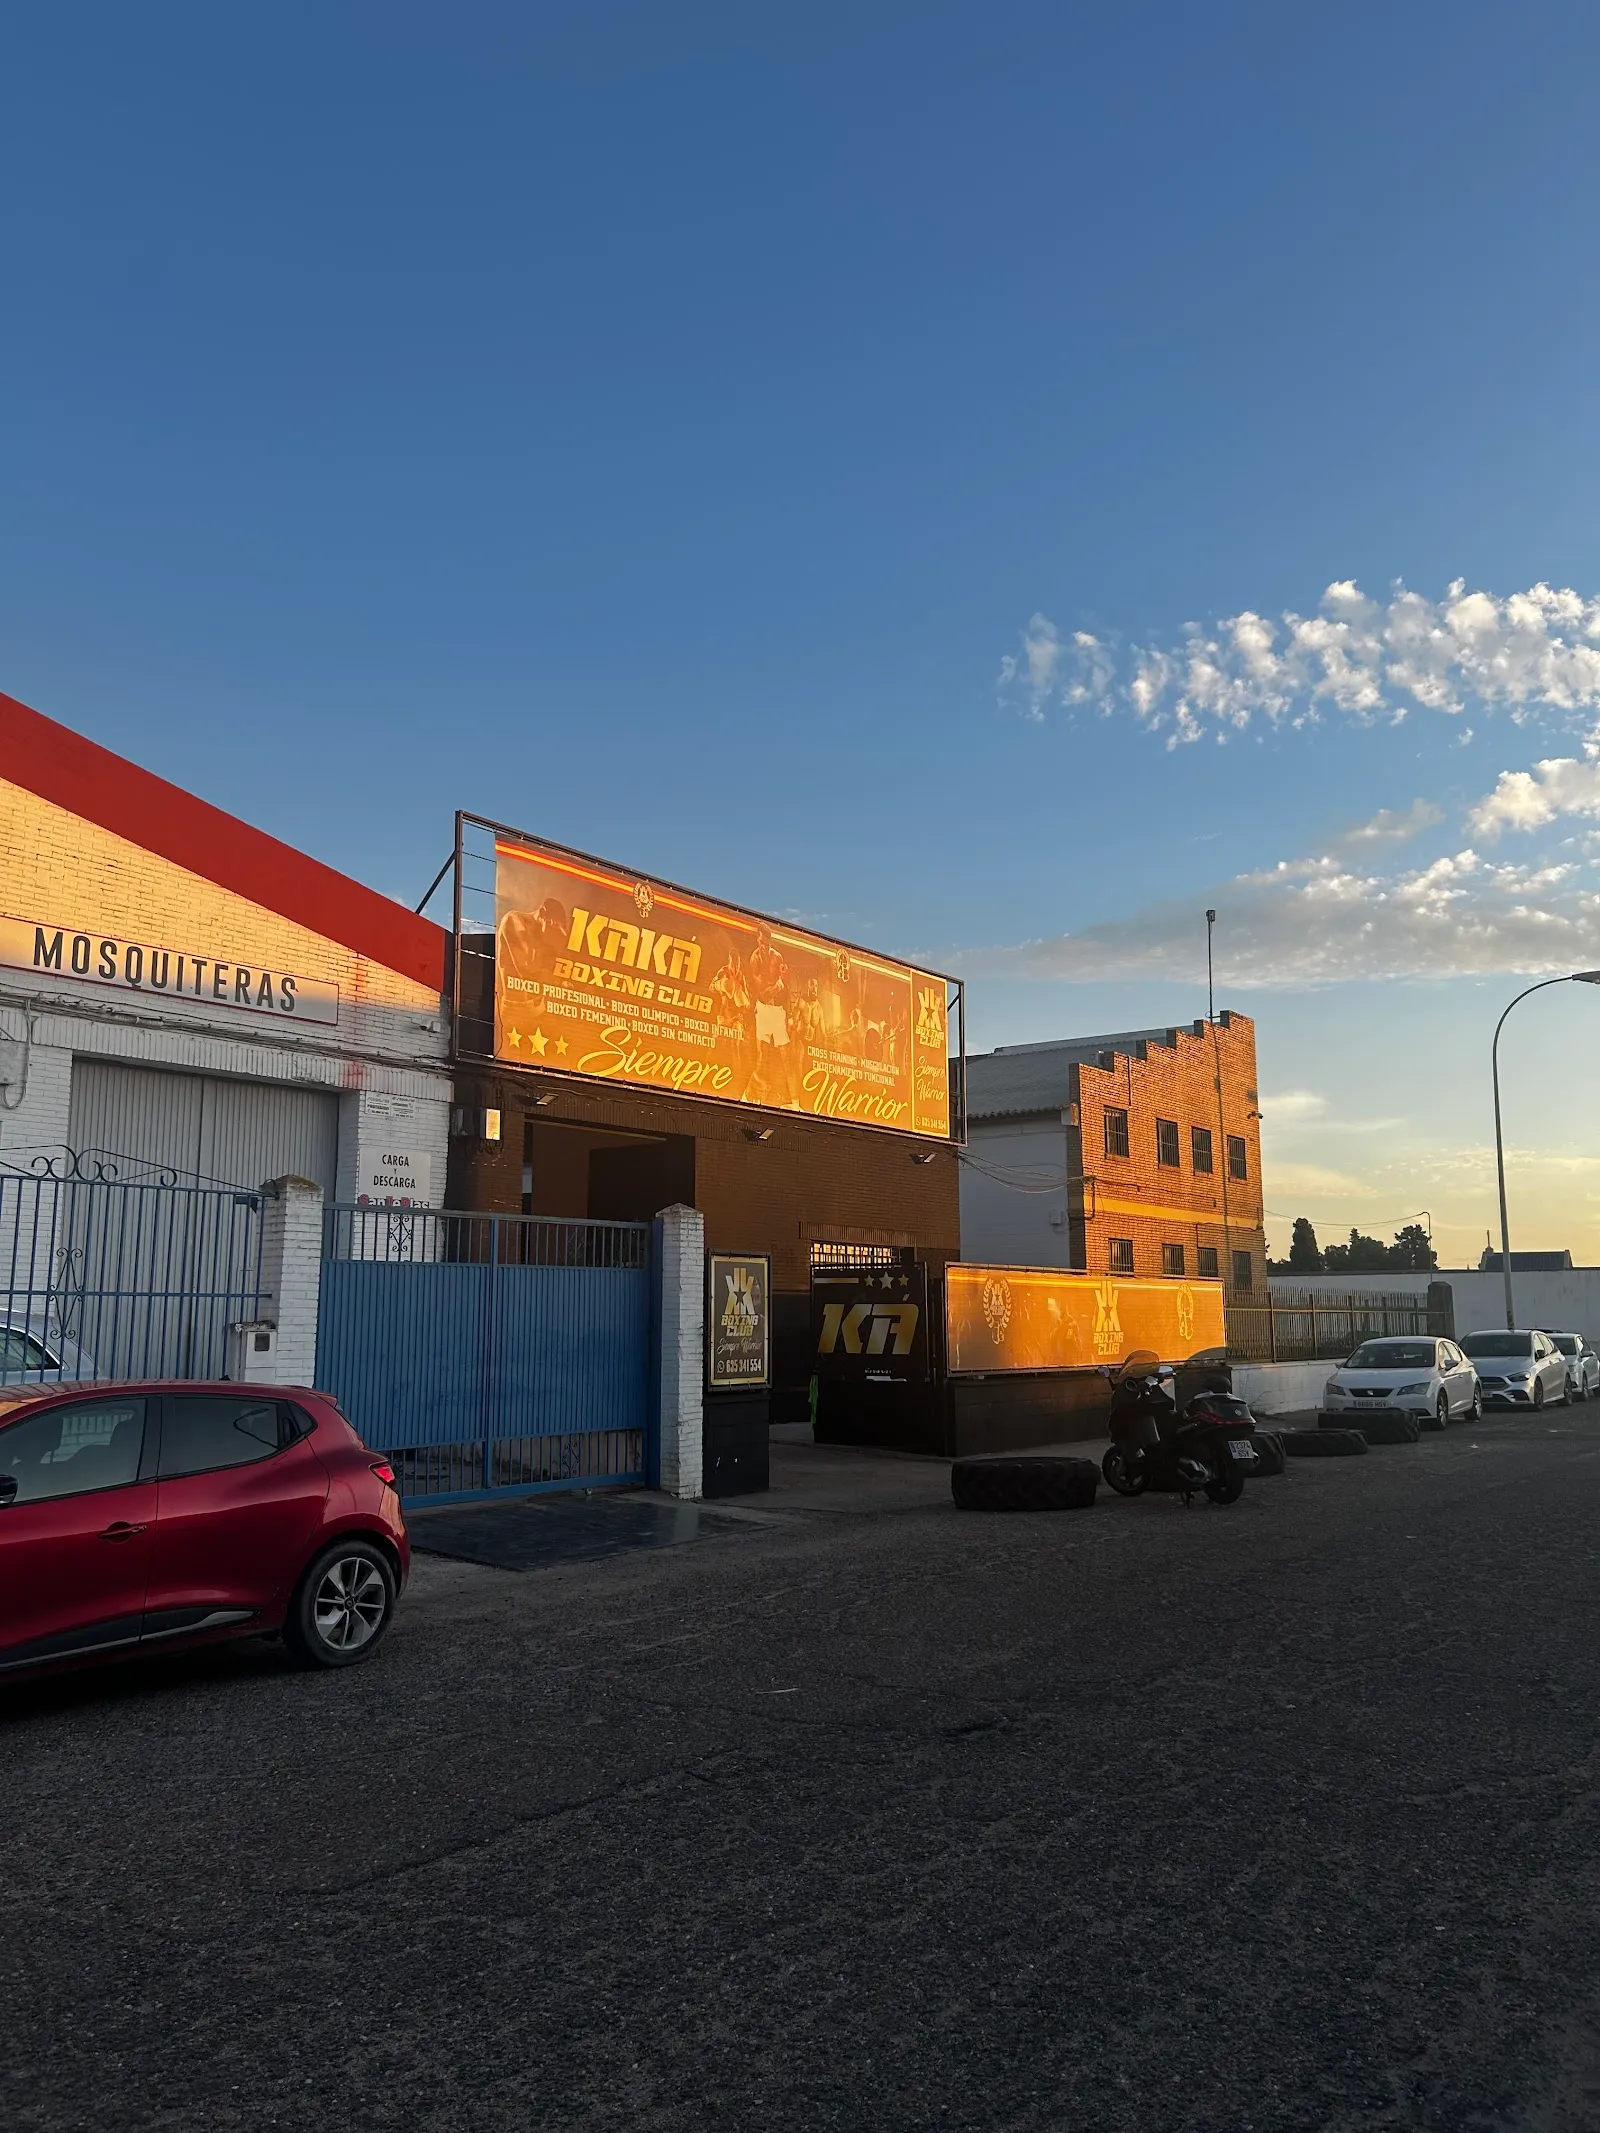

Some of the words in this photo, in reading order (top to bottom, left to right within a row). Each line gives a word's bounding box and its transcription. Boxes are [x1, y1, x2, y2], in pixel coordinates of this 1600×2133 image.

[33, 927, 298, 1012] MOSQUITERAS
[553, 958, 654, 1000] BOXING
[658, 985, 713, 1014] CLUB
[507, 976, 540, 994] BOXED
[611, 1000, 639, 1016] BOXED
[684, 1017, 709, 1033] BOXED
[547, 1001, 577, 1018] BOXED
[580, 1008, 626, 1028] FEMENINO
[632, 1020, 659, 1036] BOXED
[661, 1028, 675, 1040] SIN
[678, 1031, 716, 1049] CONTACTO
[915, 1024, 944, 1041] BOXING
[919, 1035, 941, 1049] CLUB
[577, 1025, 733, 1090] Siempre
[807, 1045, 828, 1060] CROSS
[829, 1051, 857, 1066] TRAINING
[915, 1055, 945, 1085] Siempre
[864, 1071, 896, 1087] FUNCIONAL
[802, 1068, 908, 1120] Warrior
[916, 1078, 946, 1101] Warrior
[382, 1154, 409, 1167] CARGA
[373, 1175, 416, 1189] DESCARGA
[720, 1314, 759, 1326] BOXING
[726, 1325, 754, 1337] CLUB
[1093, 1331, 1124, 1344] BOXING
[1097, 1342, 1121, 1356] CLUB
[750, 1358, 762, 1372] 554
